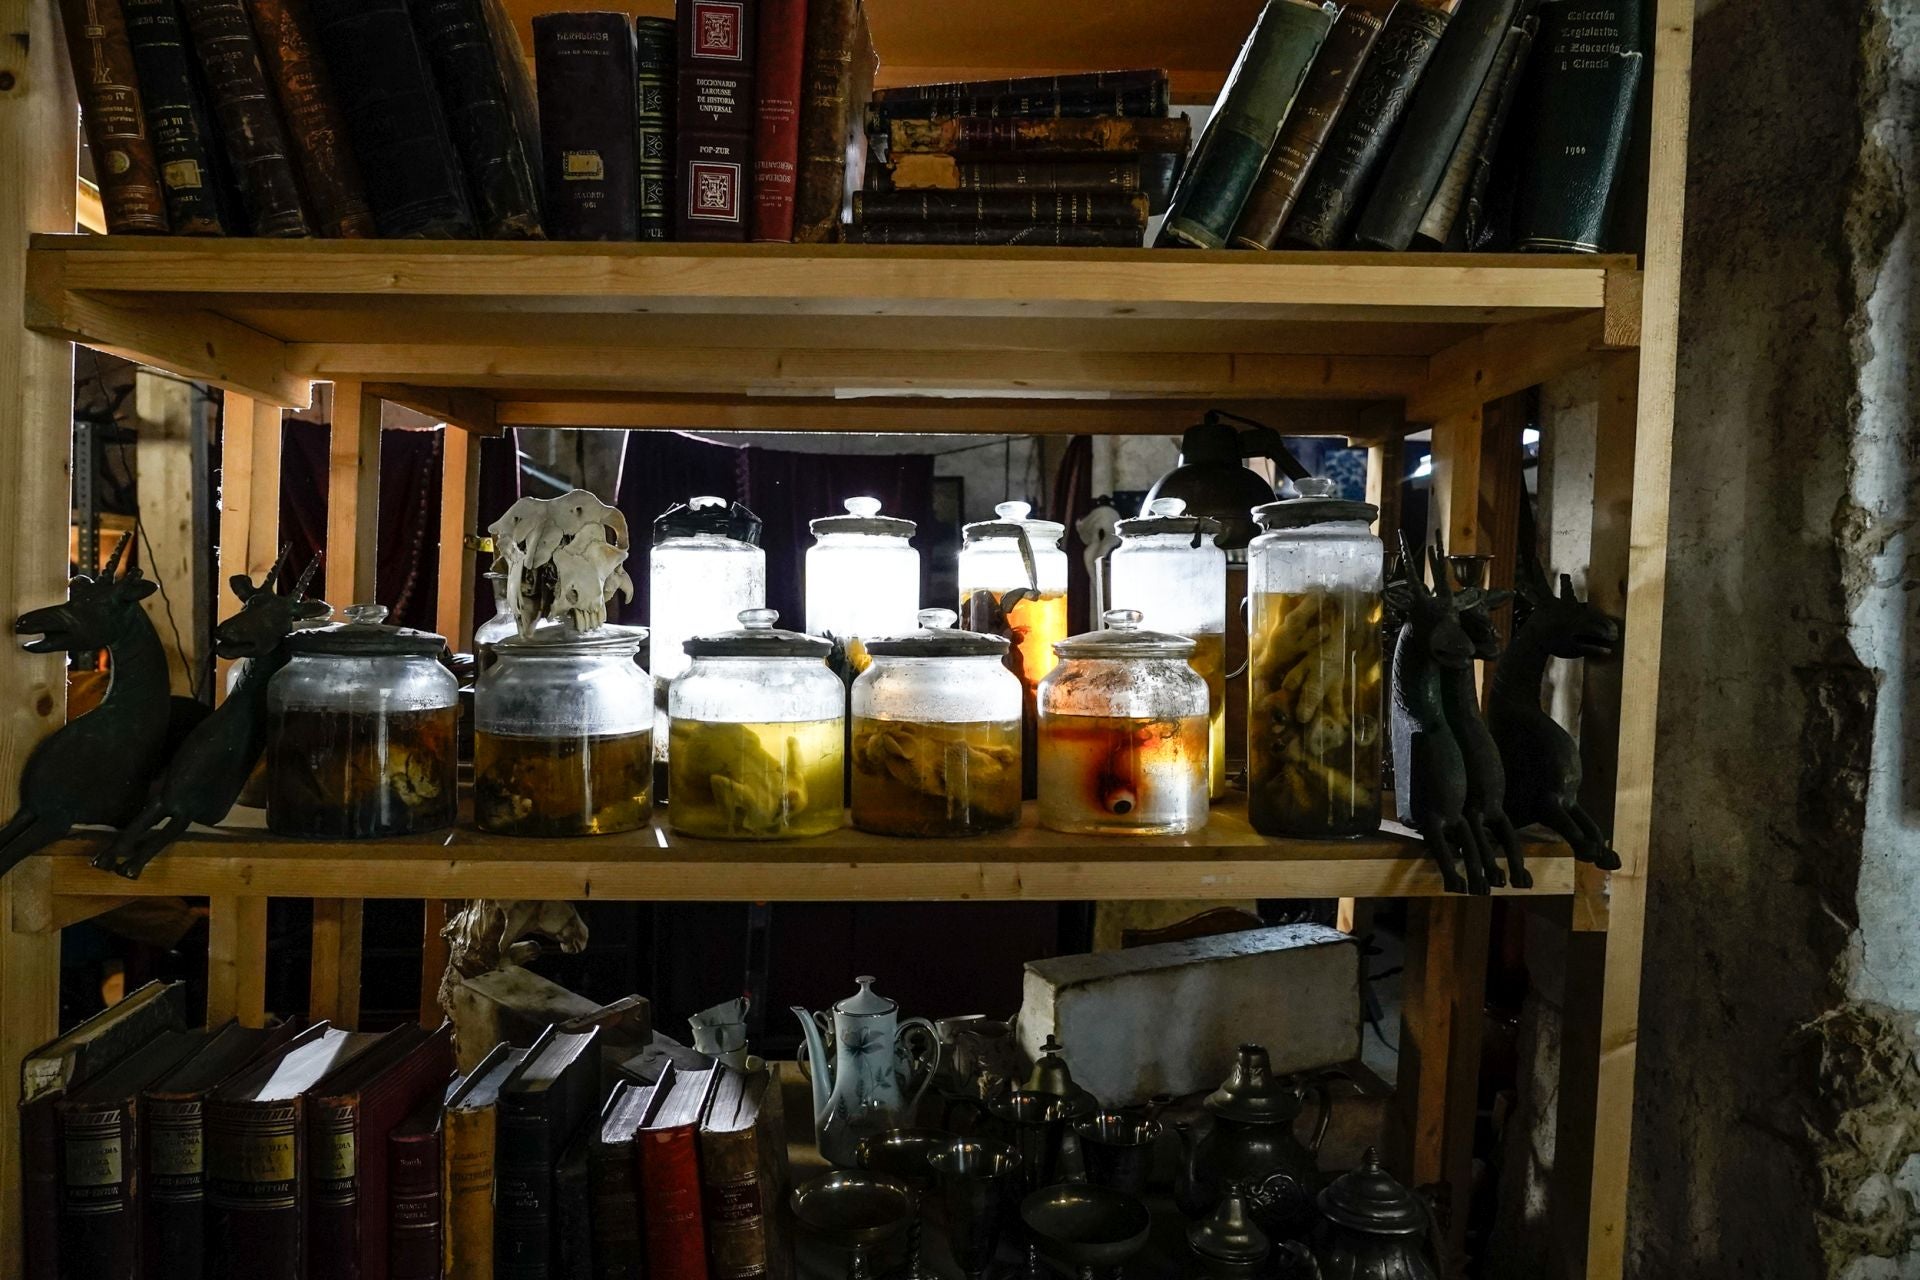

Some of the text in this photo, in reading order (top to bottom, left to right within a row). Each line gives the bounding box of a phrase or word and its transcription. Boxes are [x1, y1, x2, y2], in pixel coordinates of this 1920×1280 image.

[696, 78, 737, 88] DICCIONARIO
[701, 87, 732, 96] LAROUSSE
[697, 95, 735, 105] DE HISTORIA
[700, 104, 733, 114] UNIVERSAL
[713, 113, 719, 121] V
[699, 145, 731, 156] POP-ZUR
